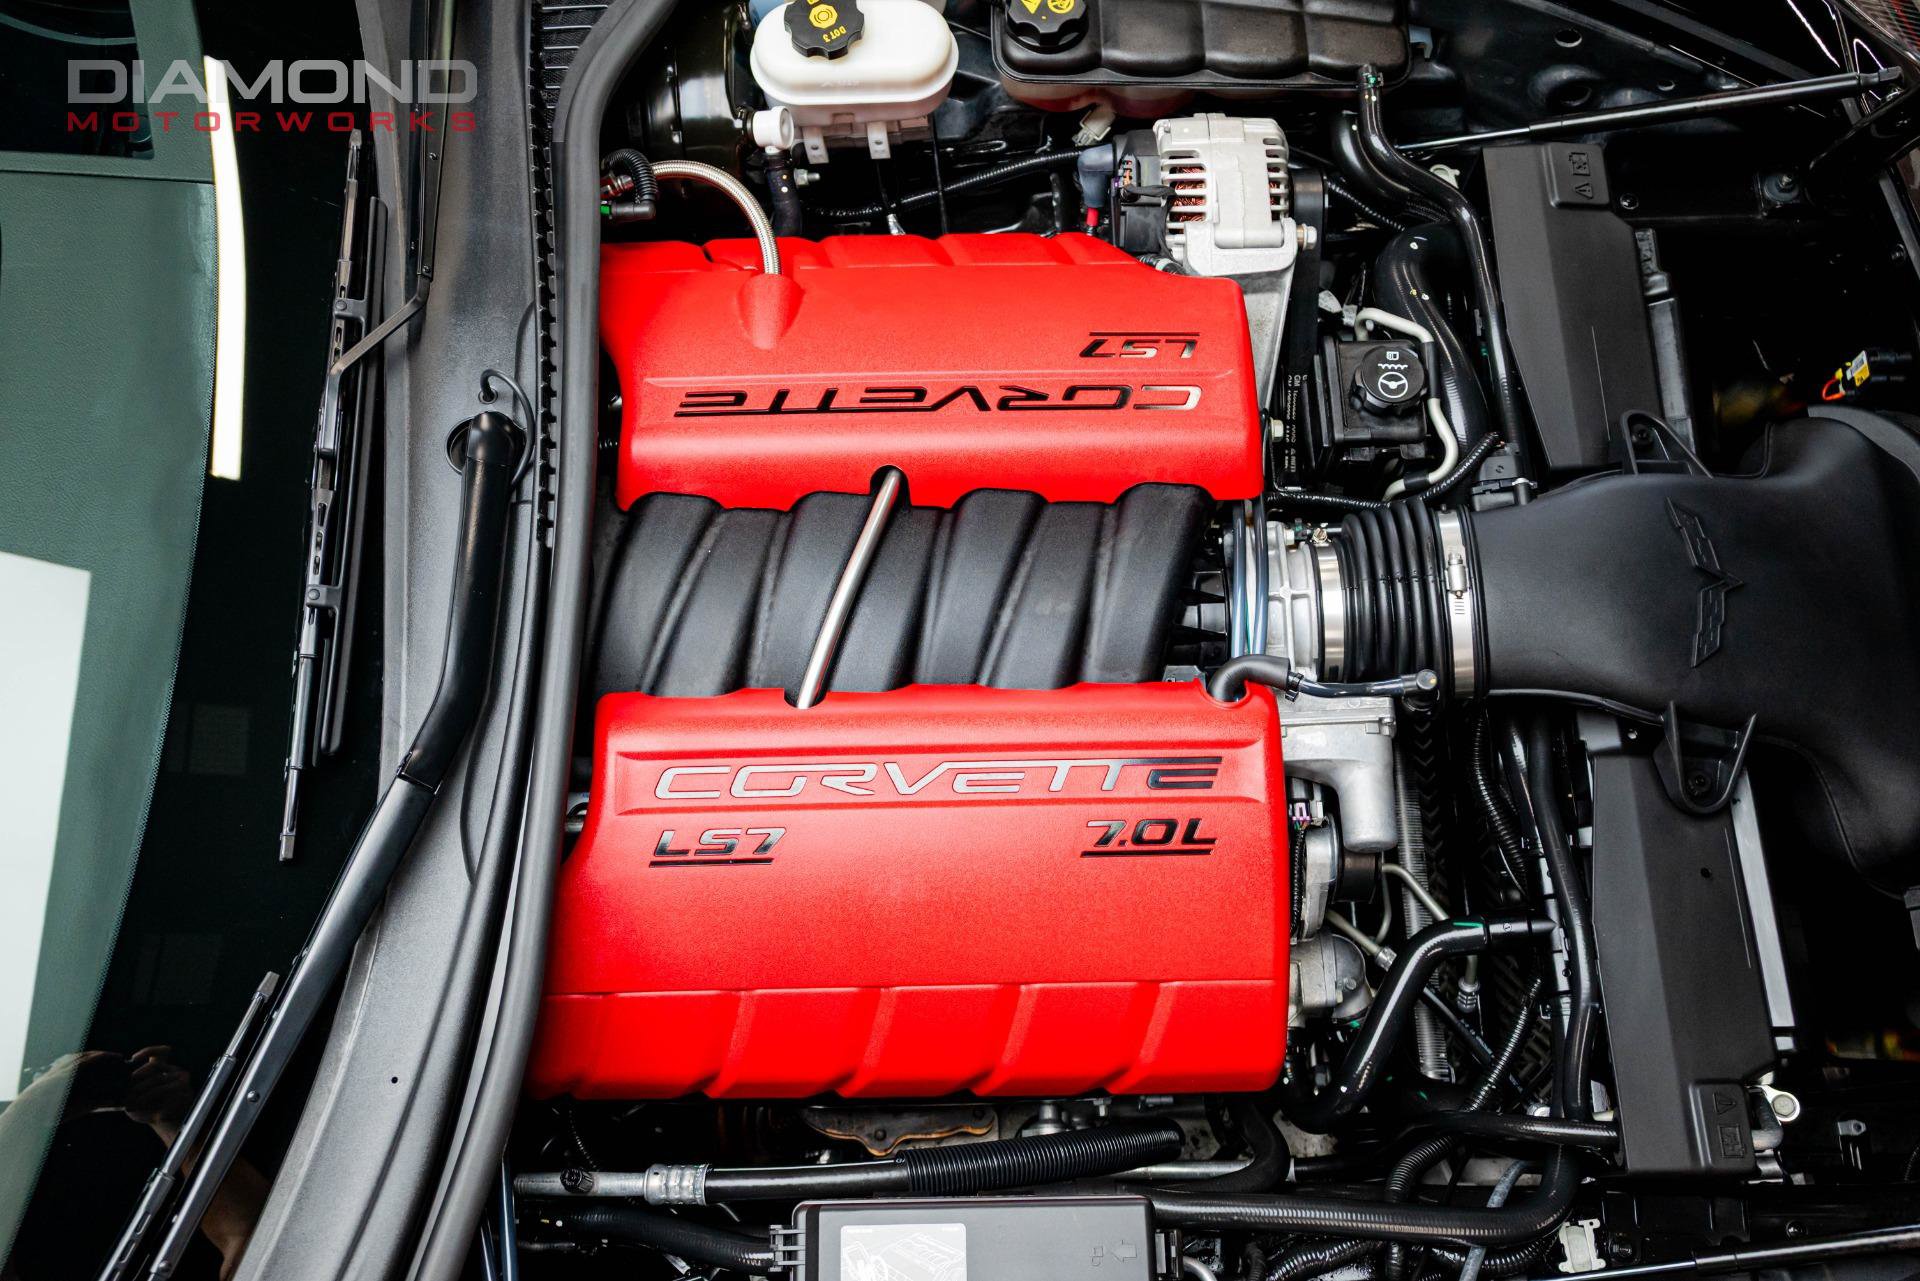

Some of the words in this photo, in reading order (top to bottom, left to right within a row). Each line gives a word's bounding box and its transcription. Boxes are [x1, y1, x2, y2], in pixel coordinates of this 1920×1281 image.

[822, 34, 831, 43] 3
[830, 25, 847, 40] DOT
[1080, 339, 1198, 358] LS7
[674, 386, 1203, 417] CORVETTE
[654, 757, 1223, 799] CORVETTE
[653, 827, 787, 856] LS7
[1086, 818, 1217, 848] 7.0L
